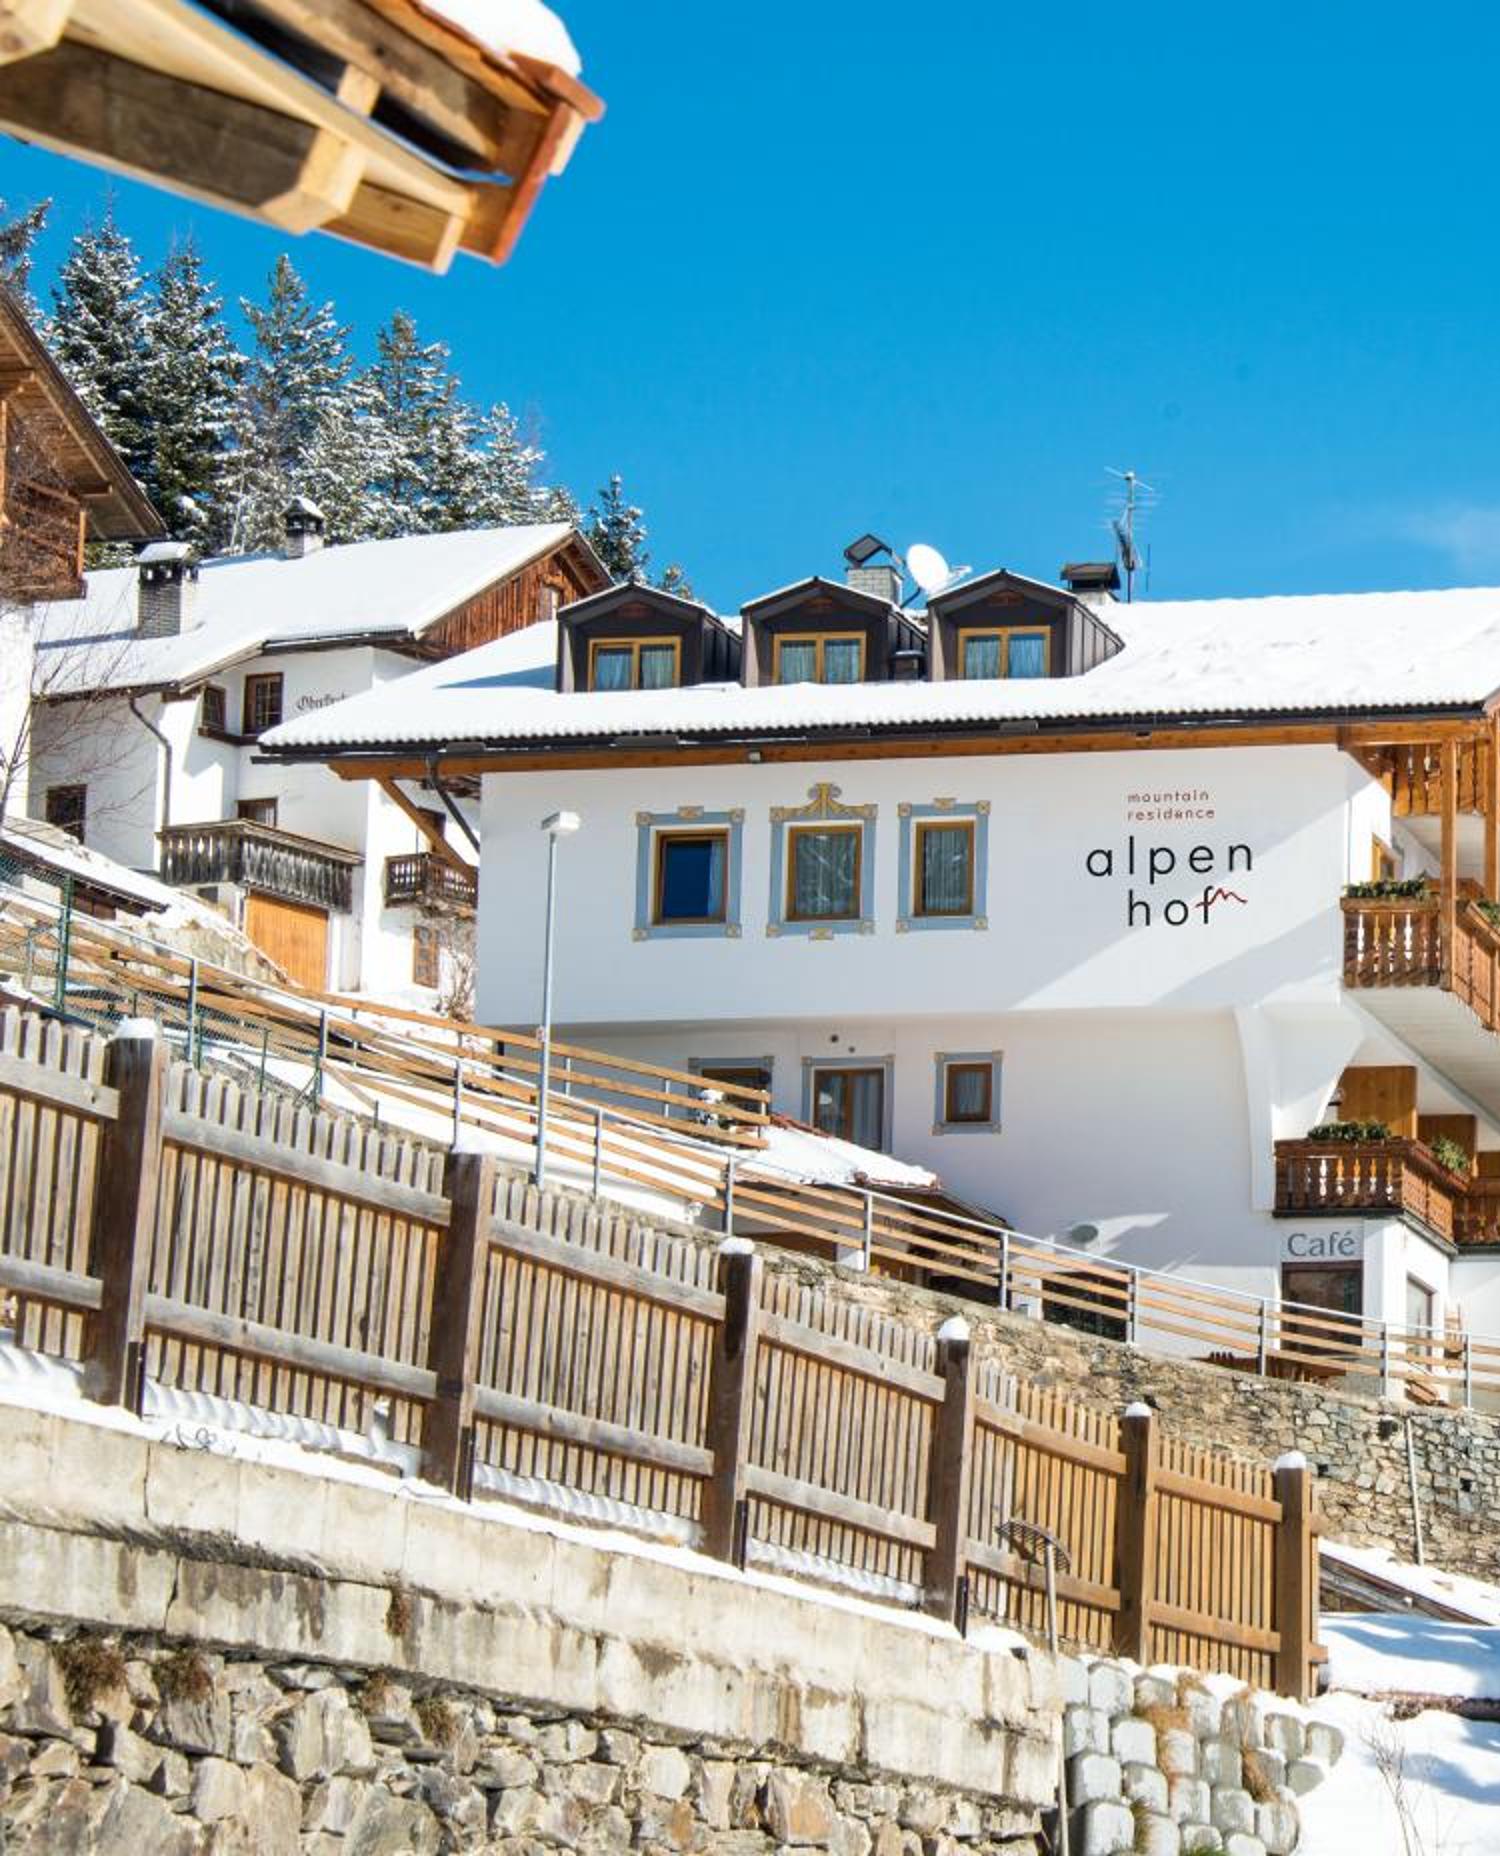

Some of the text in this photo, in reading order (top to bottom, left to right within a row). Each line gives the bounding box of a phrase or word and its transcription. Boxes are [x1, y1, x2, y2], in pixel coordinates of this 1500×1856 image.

[1127, 789, 1209, 803] mountain
[1127, 806, 1215, 821] residence
[1086, 835, 1252, 885] alpen
[1128, 885, 1216, 927] hof
[1287, 1229, 1355, 1257] Café
